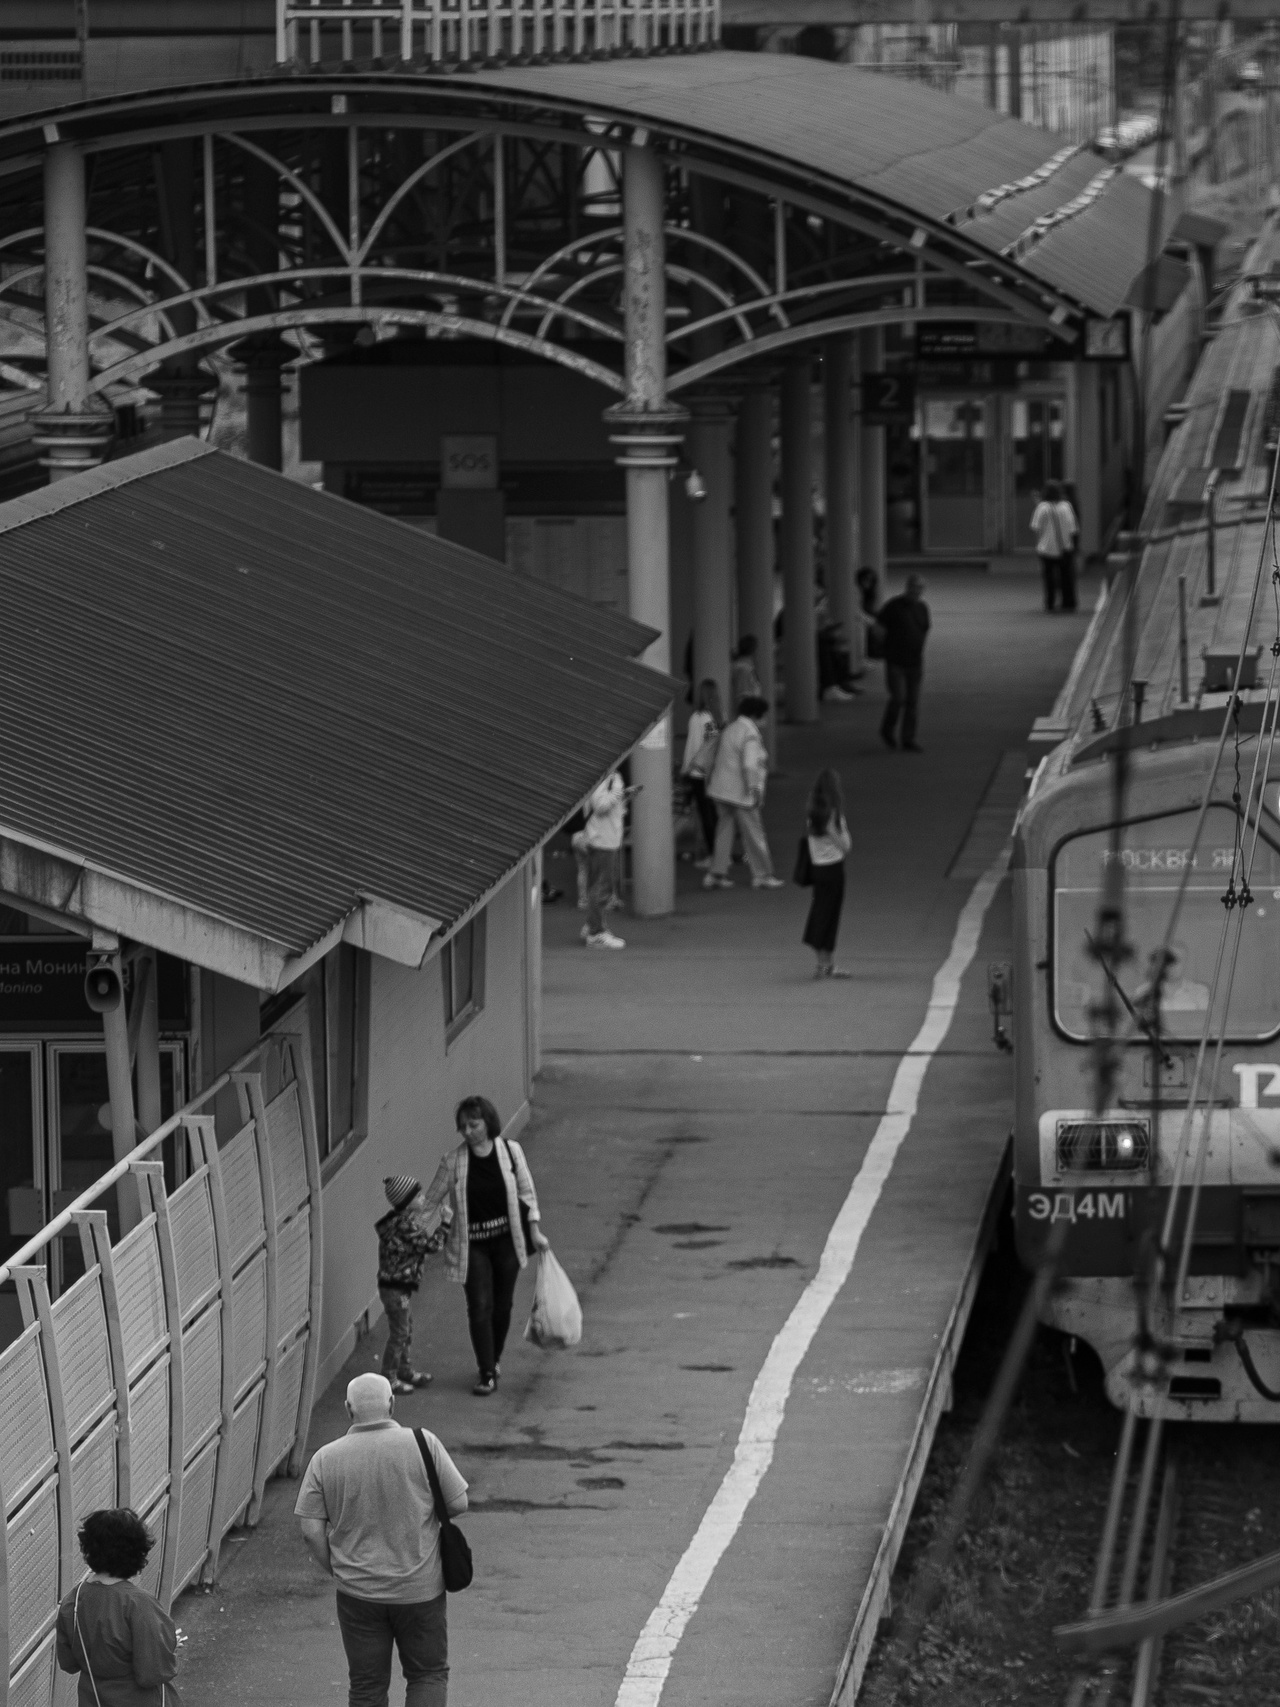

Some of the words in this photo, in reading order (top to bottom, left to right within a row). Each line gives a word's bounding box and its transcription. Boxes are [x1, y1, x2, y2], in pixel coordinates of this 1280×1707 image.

[879, 377, 900, 408] 2
[448, 453, 490, 472] SOS
[26, 959, 88, 975] Монин
[1028, 1192, 1126, 1224] ЭД4М
